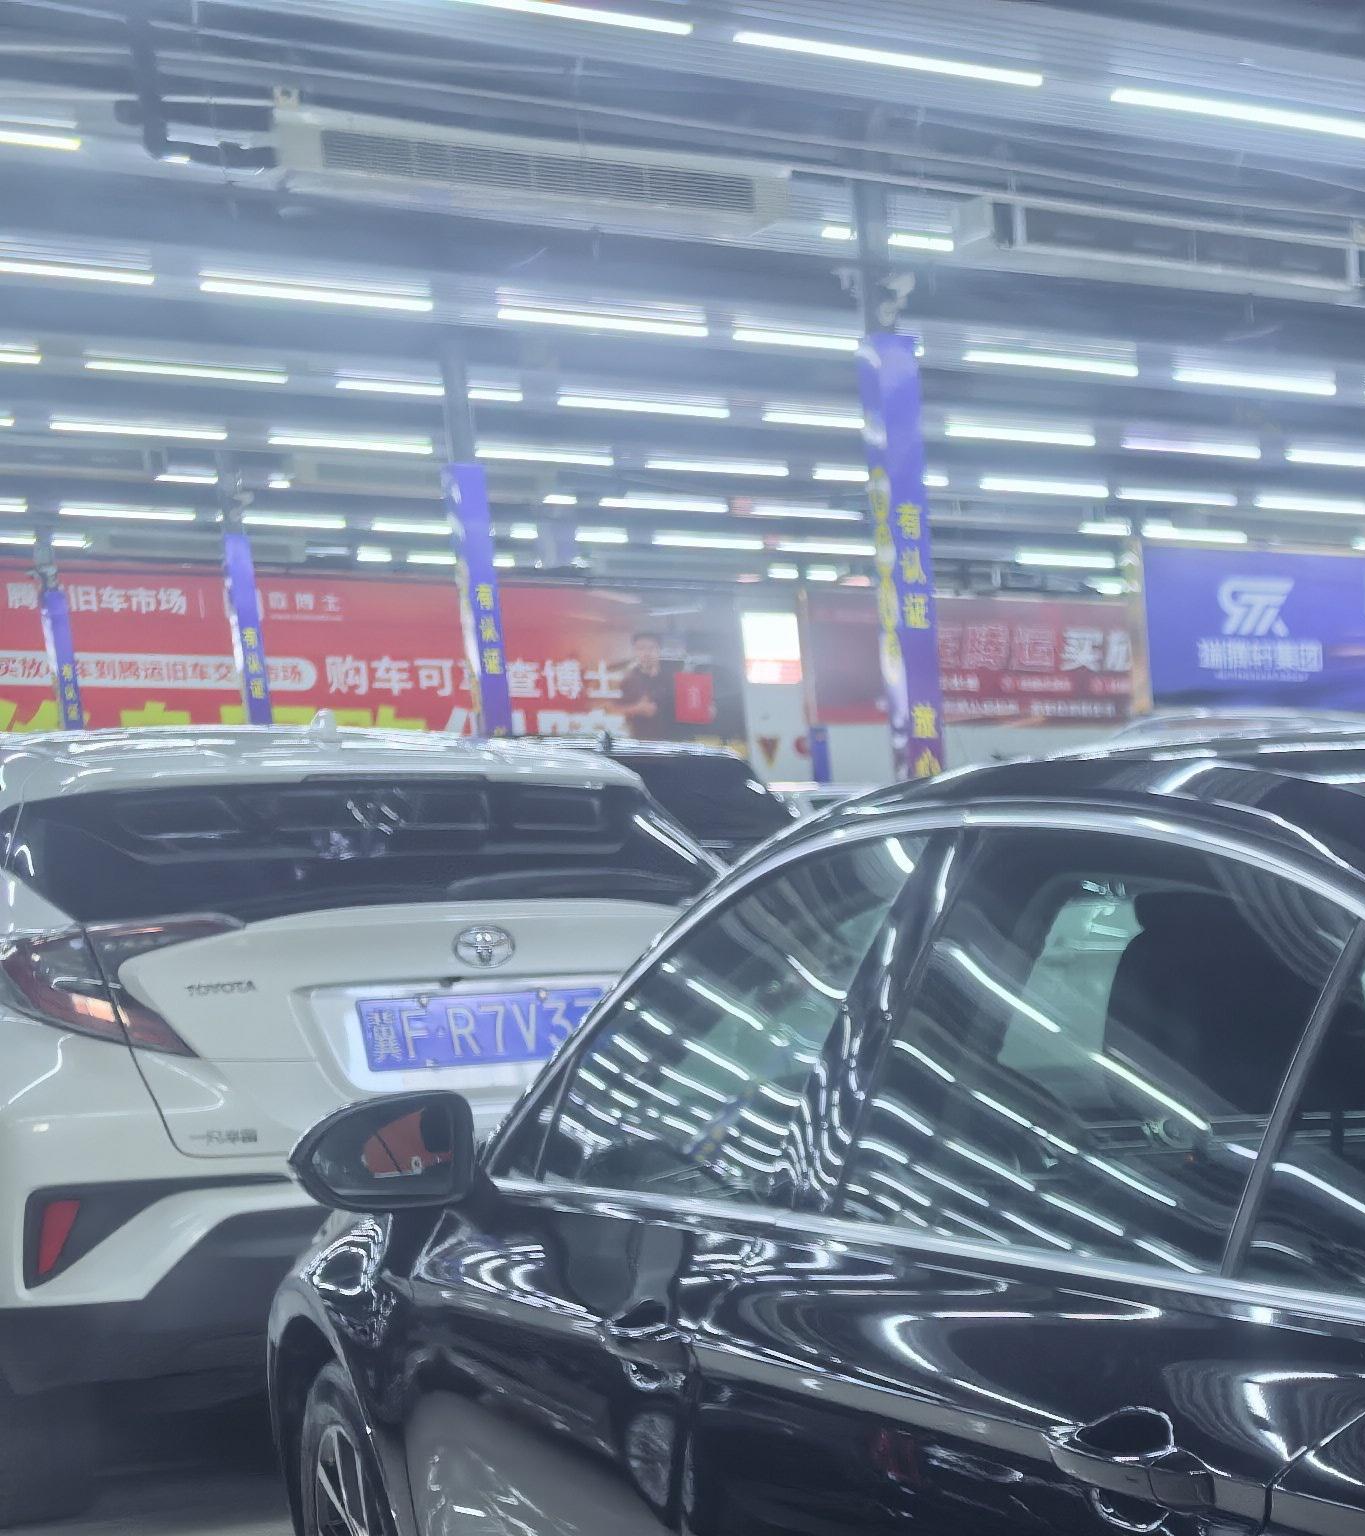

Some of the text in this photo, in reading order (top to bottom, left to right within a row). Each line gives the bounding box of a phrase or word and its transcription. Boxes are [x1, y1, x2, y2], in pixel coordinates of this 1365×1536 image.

[325, 655, 625, 700] 购车可查博士
